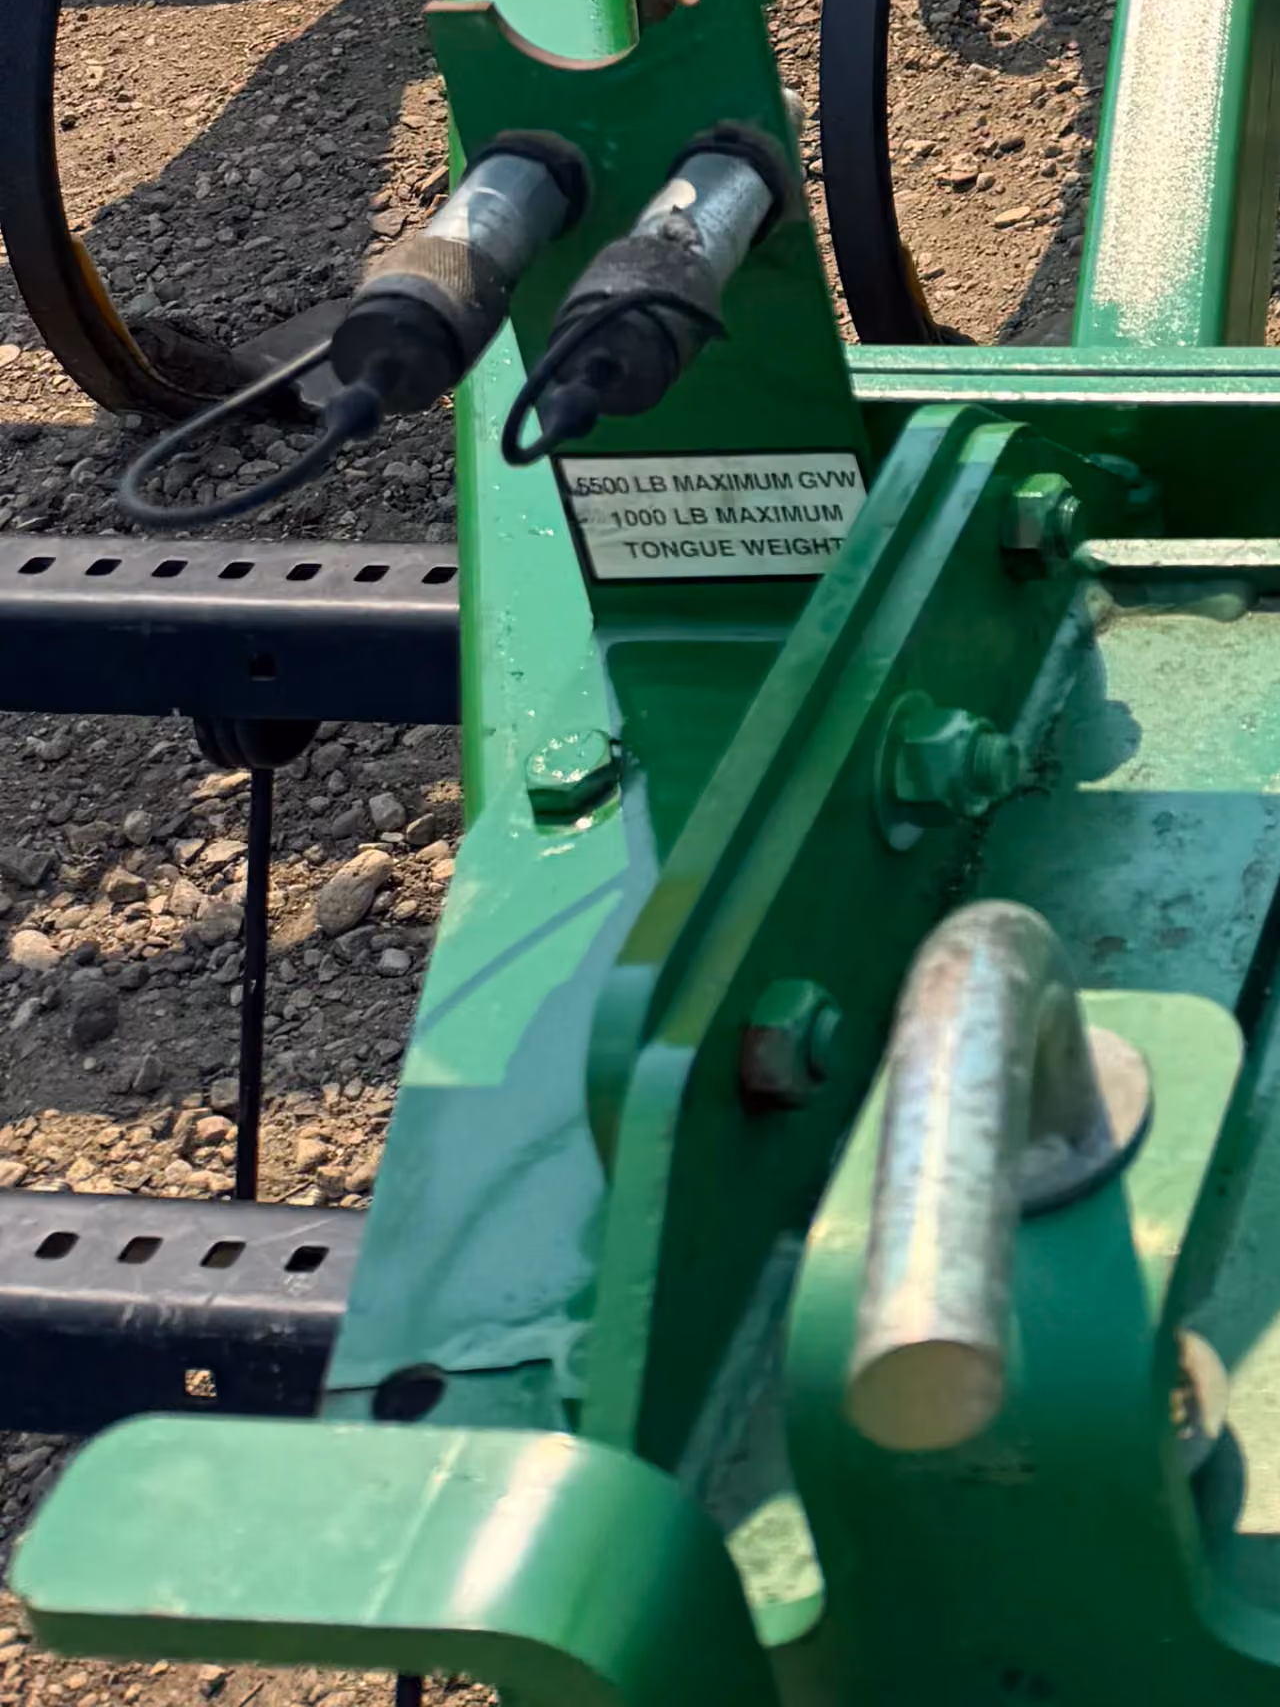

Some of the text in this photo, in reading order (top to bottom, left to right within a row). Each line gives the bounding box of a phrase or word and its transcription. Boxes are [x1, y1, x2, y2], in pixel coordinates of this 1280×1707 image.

[636, 475, 667, 493] LB
[673, 472, 792, 492] MAXIMUM
[798, 470, 856, 489] GVW
[611, 504, 844, 528] 1000 LB MAXIMUM
[624, 536, 847, 559] TONGUE WEIGHT
